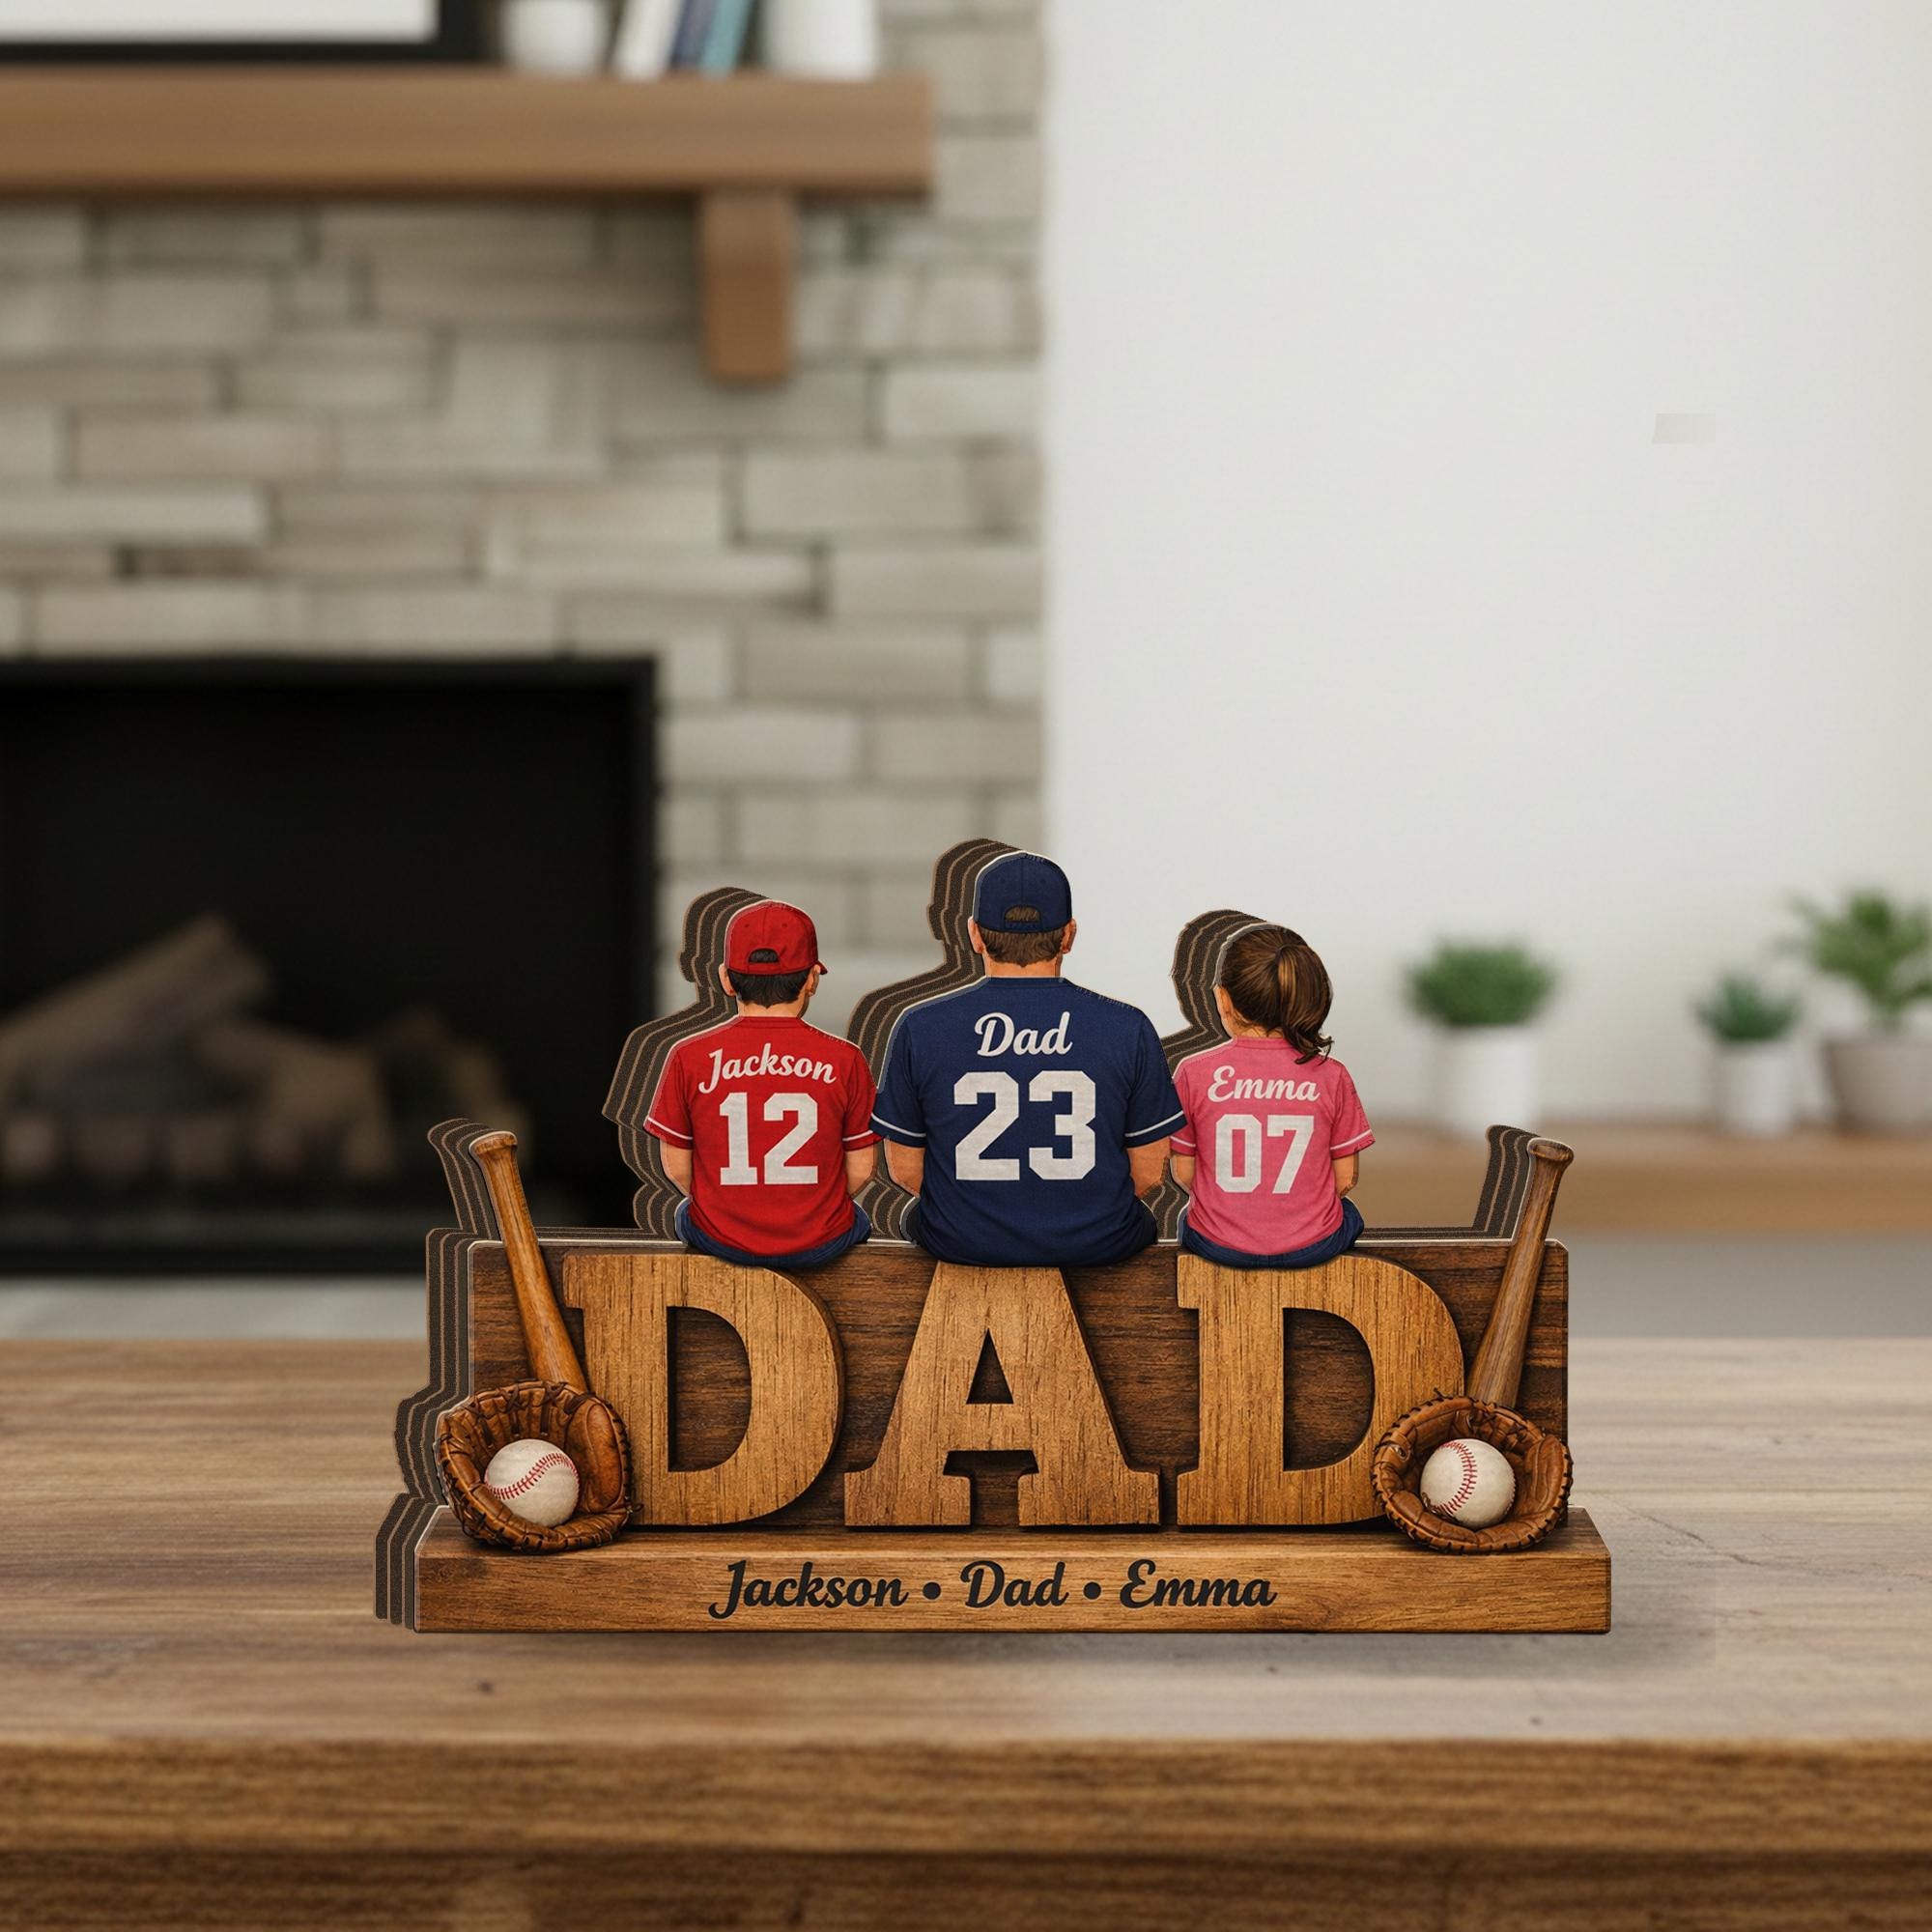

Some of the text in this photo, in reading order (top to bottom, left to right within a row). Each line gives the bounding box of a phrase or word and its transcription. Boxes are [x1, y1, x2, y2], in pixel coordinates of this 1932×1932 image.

[697, 1041, 837, 1095] Jackson
[975, 1011, 1073, 1058] Dad
[1207, 1065, 1321, 1104] Emma
[718, 1092, 819, 1186] 12
[953, 1070, 1096, 1180] 23
[1214, 1114, 1316, 1195] 07
[562, 1254, 1465, 1528] DAD
[707, 1557, 1279, 1621] Jackson Dad Emma
